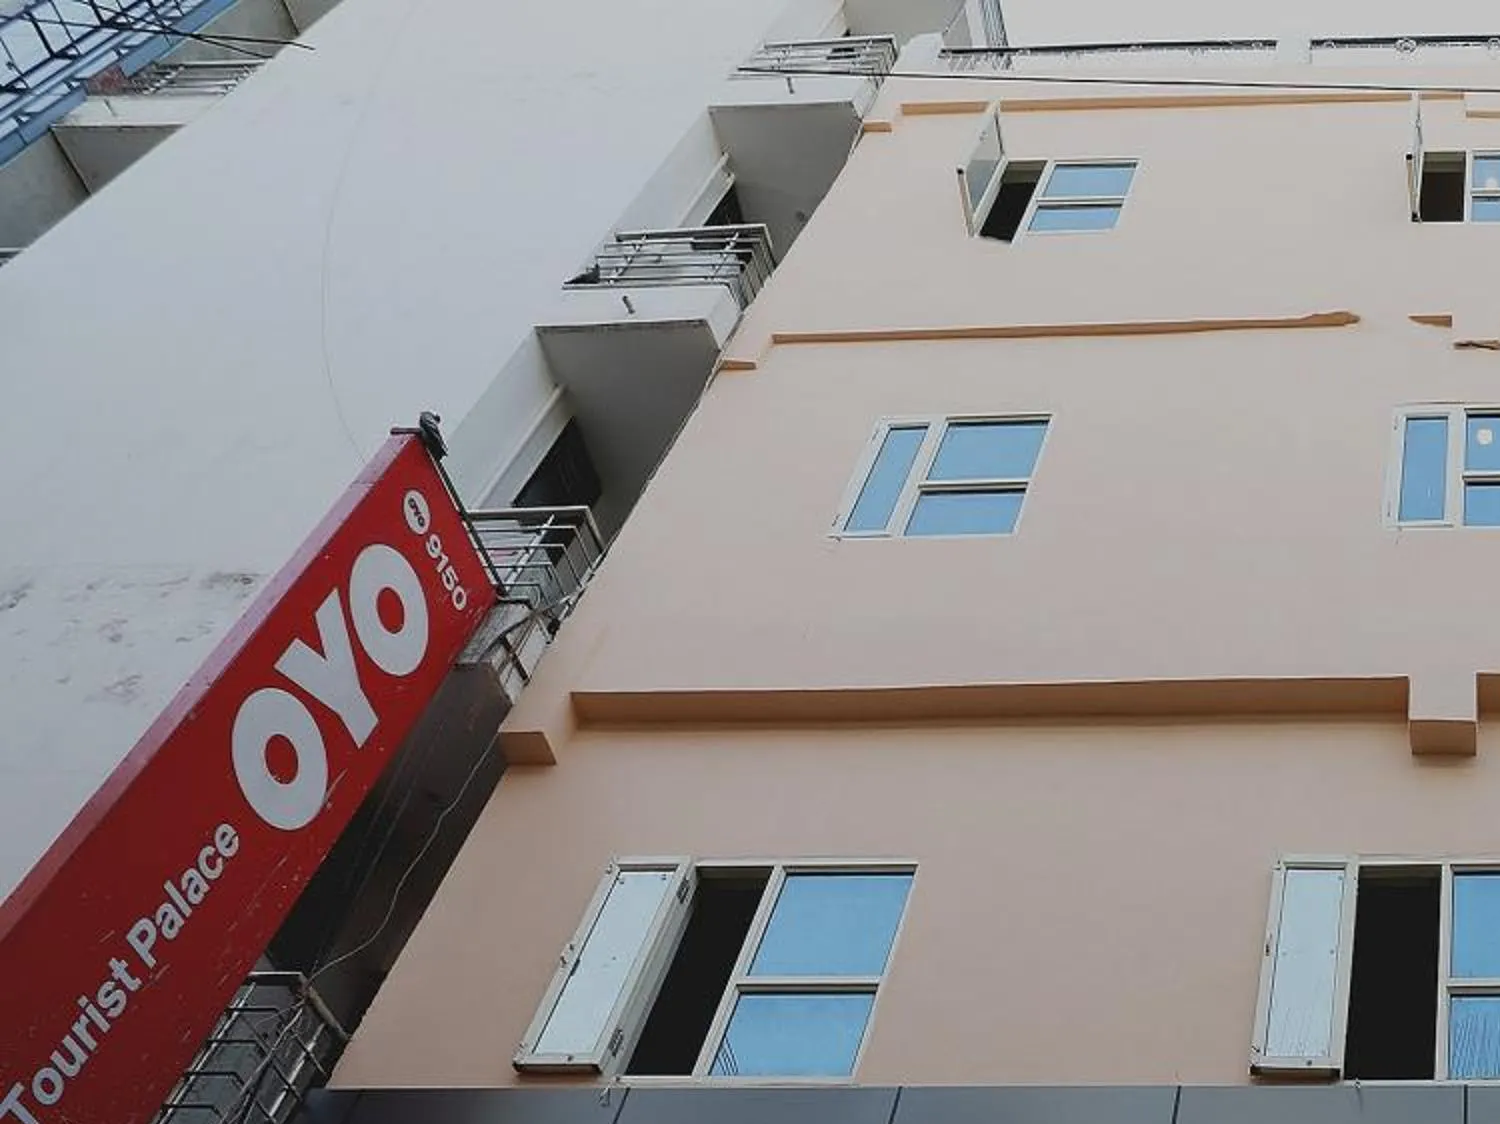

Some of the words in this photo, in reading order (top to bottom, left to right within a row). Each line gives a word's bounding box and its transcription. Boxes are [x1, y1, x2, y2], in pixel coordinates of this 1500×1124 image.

[425, 533, 467, 611] 9150
[231, 543, 428, 831] OYO
[126, 822, 240, 969] Palace
